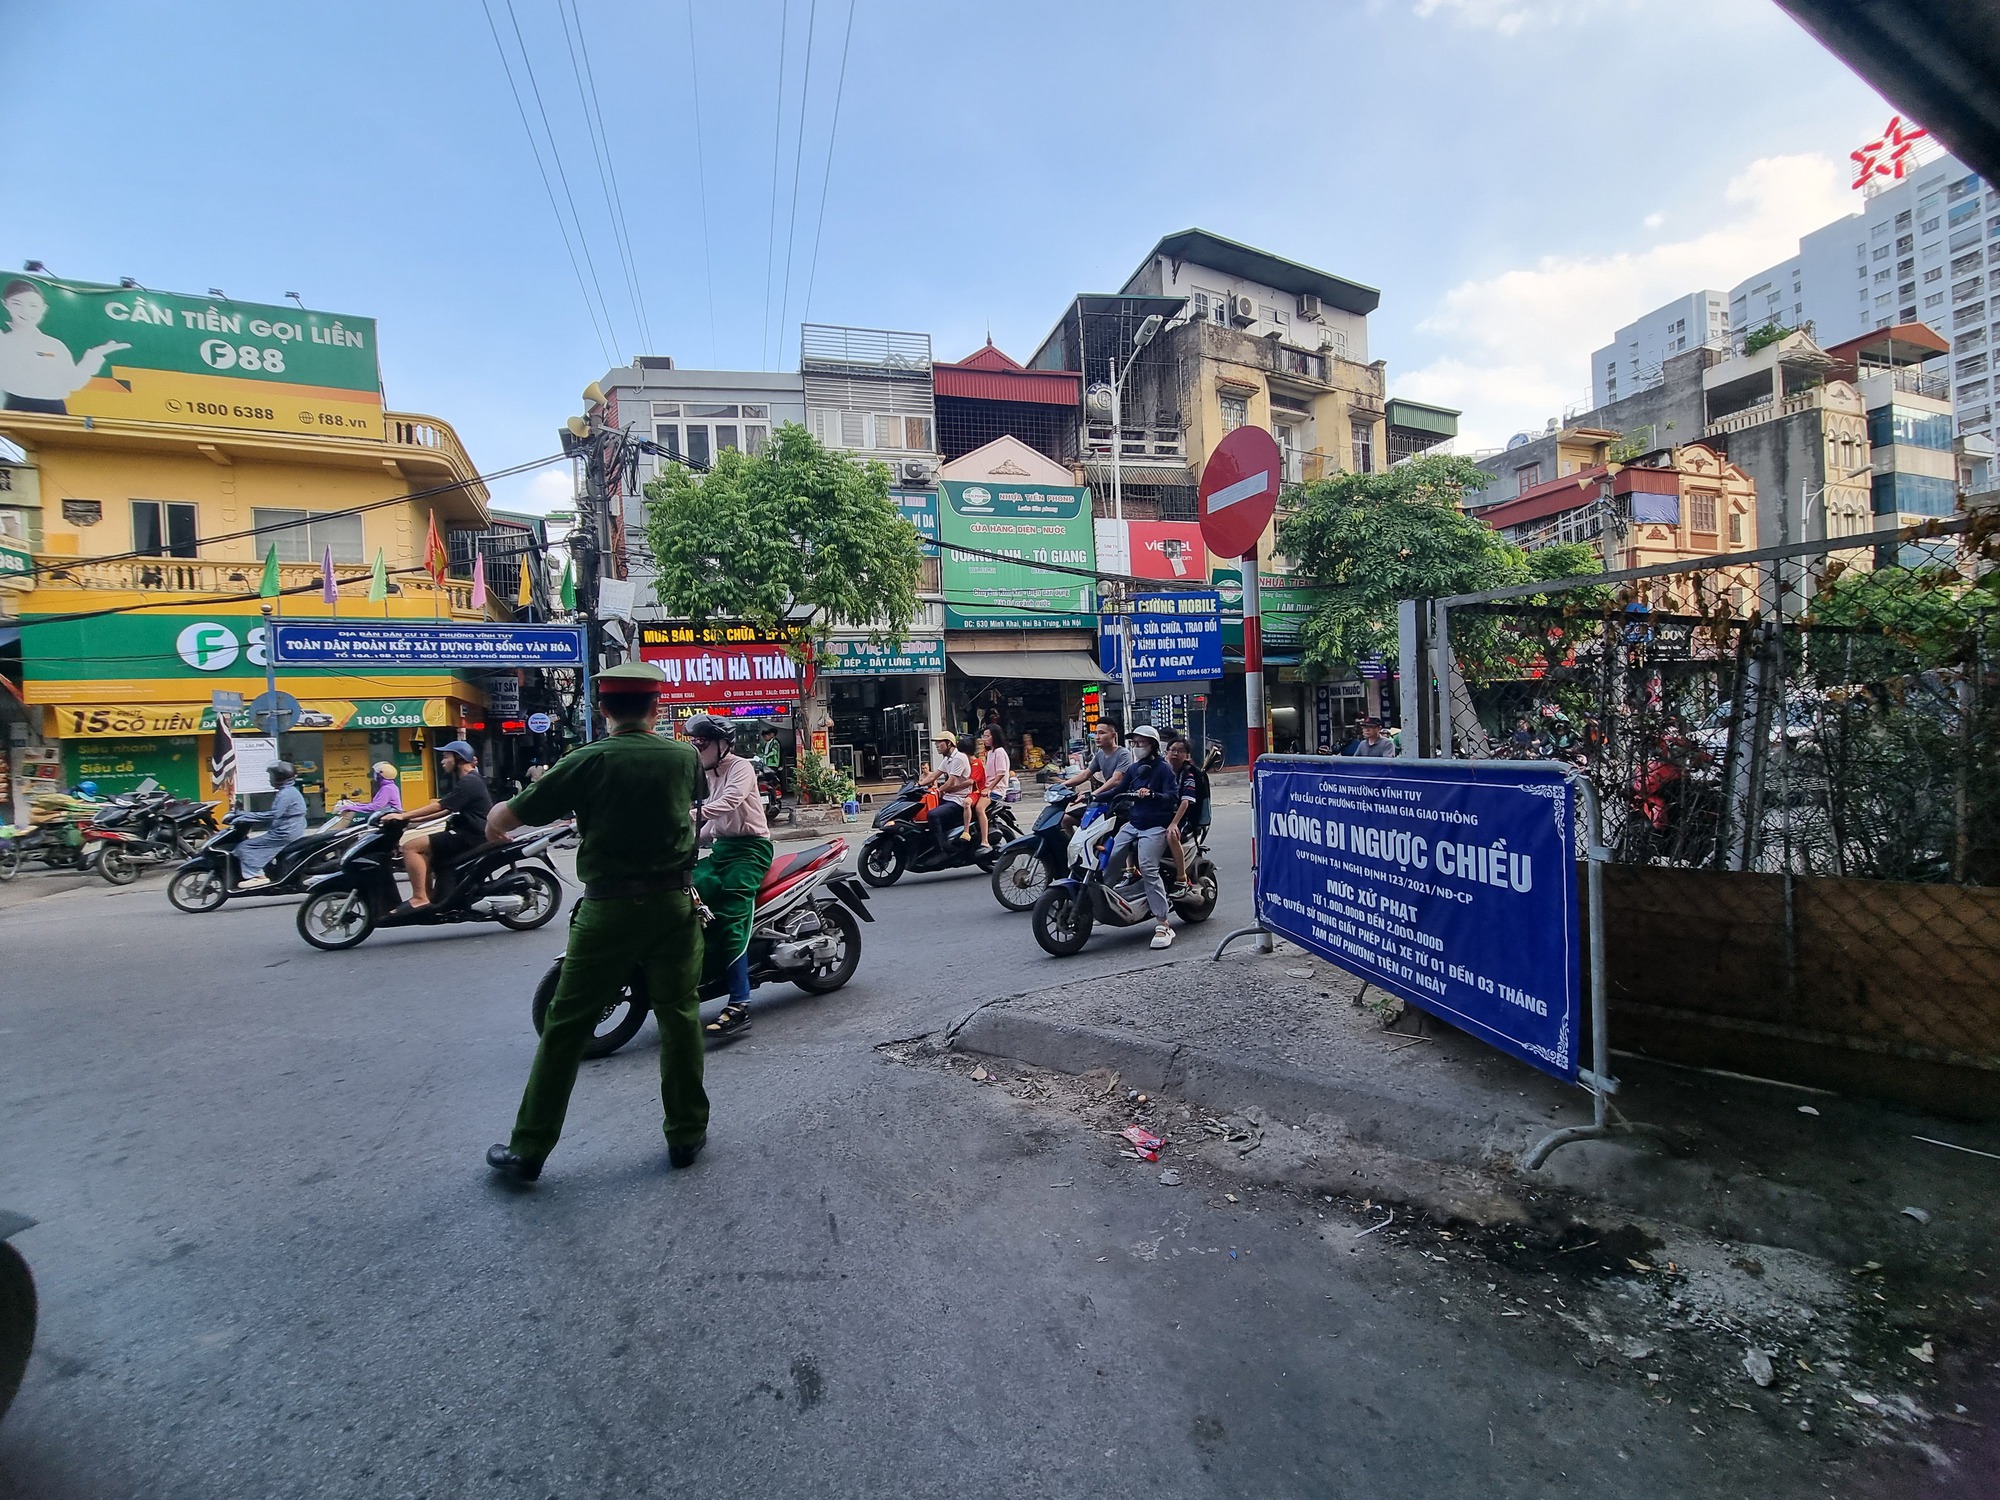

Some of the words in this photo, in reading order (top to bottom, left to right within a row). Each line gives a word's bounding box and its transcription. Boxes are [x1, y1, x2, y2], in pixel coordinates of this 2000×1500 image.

[104, 296, 174, 327] CẦN
[181, 306, 241, 335] TIỀN
[249, 319, 302, 345] GỌI
[311, 320, 364, 349] LIỀN
[186, 401, 229, 417] 1800
[233, 405, 274, 421] 6388
[317, 412, 367, 429] f88.vn
[998, 492, 1023, 503] NHỰA
[1047, 494, 1075, 504] PHONG
[922, 514, 935, 528] DA
[1051, 549, 1087, 563] GIANG
[1178, 599, 1217, 614] MOBILE
[976, 619, 988, 628] 630
[990, 619, 1005, 628] Minh
[1143, 620, 1160, 635] SỬA
[1185, 621, 1203, 633] TRAO
[1204, 617, 1218, 632] ĐỔI
[643, 629, 669, 644] MUA
[671, 626, 694, 642] BÁN
[727, 625, 756, 641] CHỮA
[286, 638, 321, 651] TOÀN
[324, 639, 350, 651] DÂN
[353, 639, 387, 651] ĐOÀN
[389, 638, 412, 651] KẾT
[414, 640, 438, 651] XÂY
[440, 641, 472, 653] DỰNG
[474, 640, 494, 652] ĐỜI
[495, 639, 523, 652] SỐNG
[526, 640, 549, 652] VĂN
[550, 641, 572, 652] HÓA
[1157, 637, 1177, 652] ĐIỆN
[1178, 638, 1199, 651] THOẠI
[686, 653, 724, 686] KIỆN
[728, 652, 751, 681] HÀ
[844, 656, 861, 668] DÉP
[869, 656, 887, 667] DÂY
[889, 656, 911, 667] LƯNG
[919, 655, 928, 666] VÍ
[929, 657, 941, 666] DA
[1160, 655, 1194, 667] NGAY
[1342, 683, 1361, 696] THUỐC
[356, 715, 389, 726] 1800
[390, 714, 421, 725] 6388
[678, 706, 693, 718] HÀ
[73, 710, 111, 734] 15
[112, 717, 146, 732] CÓ
[153, 712, 194, 731] LIỀN
[79, 762, 111, 773] Siêu
[114, 760, 135, 773] dễ
[1318, 780, 1338, 793] CÔNG
[1338, 785, 1346, 794] AN
[1347, 784, 1380, 797] PHƯỜNG
[1381, 786, 1402, 799] VĨNH
[1404, 790, 1422, 802] TUY
[1290, 791, 1302, 802] YÊU
[1302, 791, 1314, 802] CẦU
[1314, 793, 1328, 806] CÁC
[1328, 797, 1356, 810] PHƯƠNG
[1356, 800, 1373, 813] TIỆN
[1373, 803, 1398, 816] THAM
[1399, 806, 1415, 818] GIA
[1416, 807, 1438, 821] GIAO
[1439, 809, 1478, 826] THÔNG
[1326, 820, 1346, 851] ĐI
[1350, 824, 1428, 872] NGƯỢC
[1435, 838, 1533, 893] CHIỀU
[1295, 849, 1309, 860] QUY
[1309, 853, 1328, 866] ĐỊNH
[1330, 858, 1341, 870] TẠI
[1343, 861, 1363, 877] NGHỊ
[1364, 867, 1387, 882] ĐỊNH
[1388, 873, 1473, 905] 123/2021/NĐ-CP
[1326, 879, 1355, 901] MỨC
[1357, 886, 1378, 908] XỬ
[1380, 896, 1417, 923] PHẠT
[1312, 893, 1322, 906] TỪ
[1366, 911, 1385, 931] ĐẾN
[1387, 921, 1444, 952] 2.000.000Đ
[1283, 897, 1305, 915] QUYỀN
[1306, 905, 1316, 920] SỬ
[1316, 911, 1338, 928] DỤNG
[1338, 918, 1356, 935] GIẤY
[1358, 926, 1381, 946] PHÉP
[1381, 936, 1397, 954] LÁI
[1399, 944, 1413, 961] XE
[1414, 950, 1429, 967] TỪ
[1431, 957, 1445, 974] 01
[1448, 964, 1474, 987] ĐẾN
[1477, 976, 1494, 995] 03
[1497, 983, 1548, 1017] THÁNG
[1311, 924, 1327, 941] TẠM
[1328, 934, 1342, 948] GIỮ
[1342, 941, 1376, 961] PHƯƠNG
[1376, 952, 1399, 974] TIỆN
[1401, 965, 1414, 981] 07
[1415, 971, 1447, 996] NGÀY
